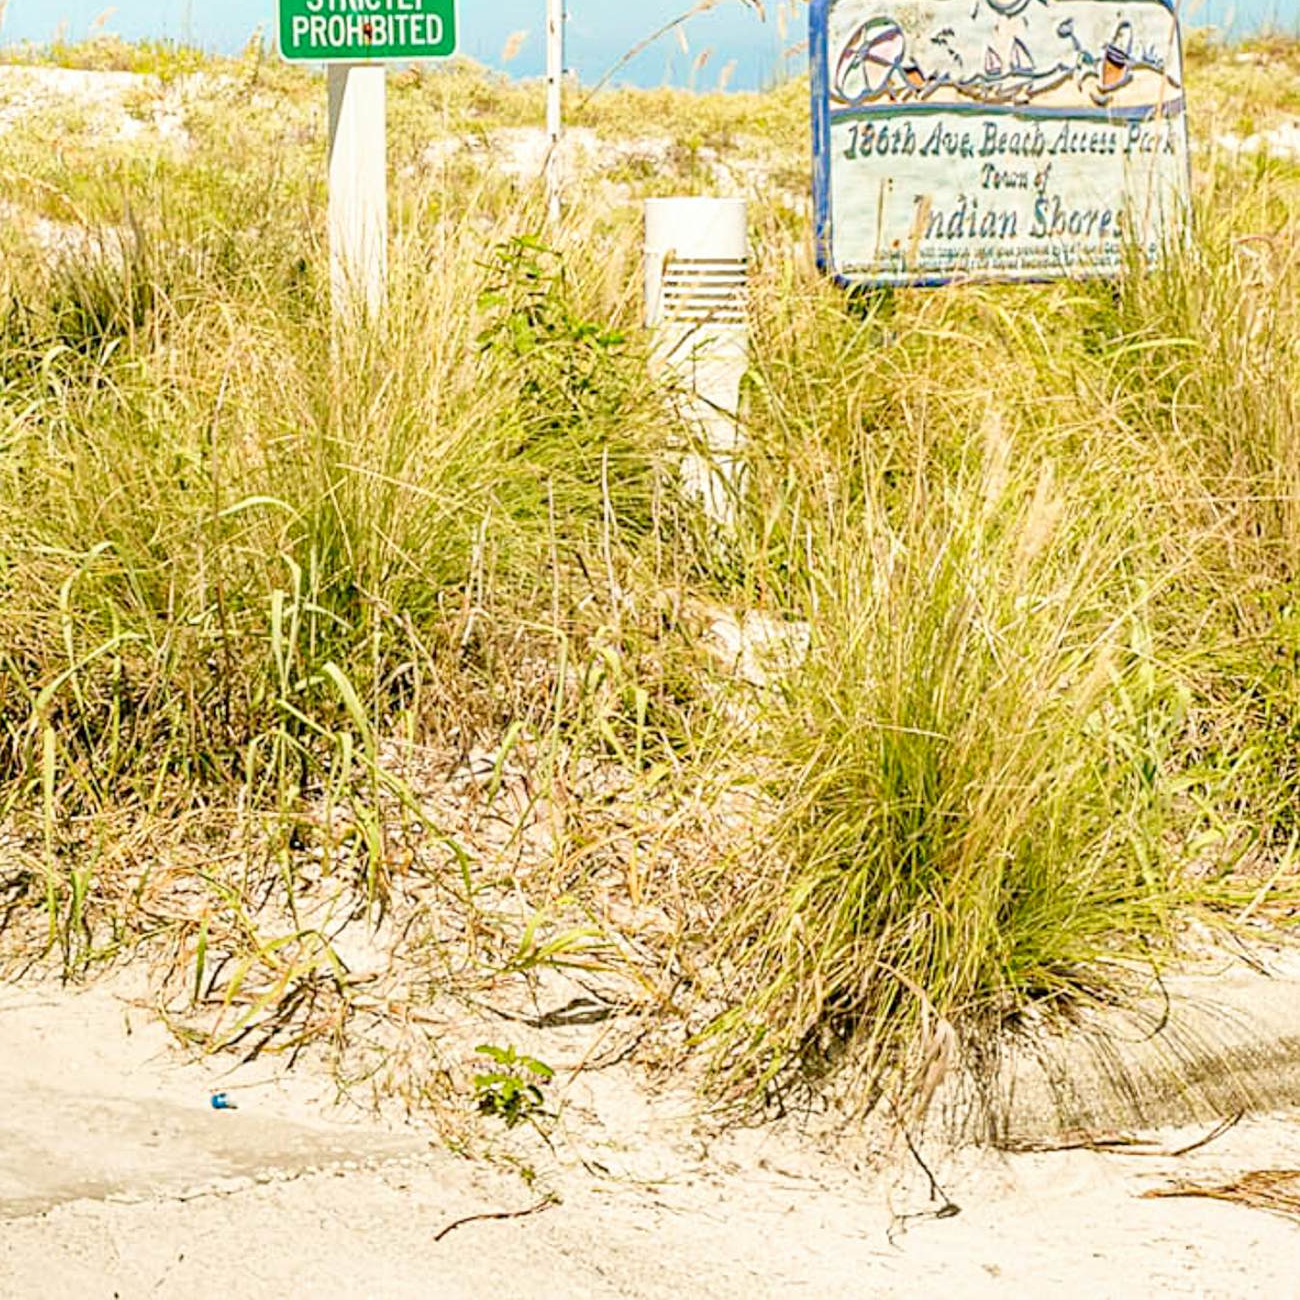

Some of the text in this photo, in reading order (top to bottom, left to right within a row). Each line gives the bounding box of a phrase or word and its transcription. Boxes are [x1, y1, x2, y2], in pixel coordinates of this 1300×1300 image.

[292, 15, 443, 47] PROHIBITED
[844, 121, 916, 160] 186th
[978, 121, 1045, 157] Beach
[1048, 122, 1116, 155] Access
[981, 161, 1052, 197] Town of
[1029, 195, 1123, 239] Shores
